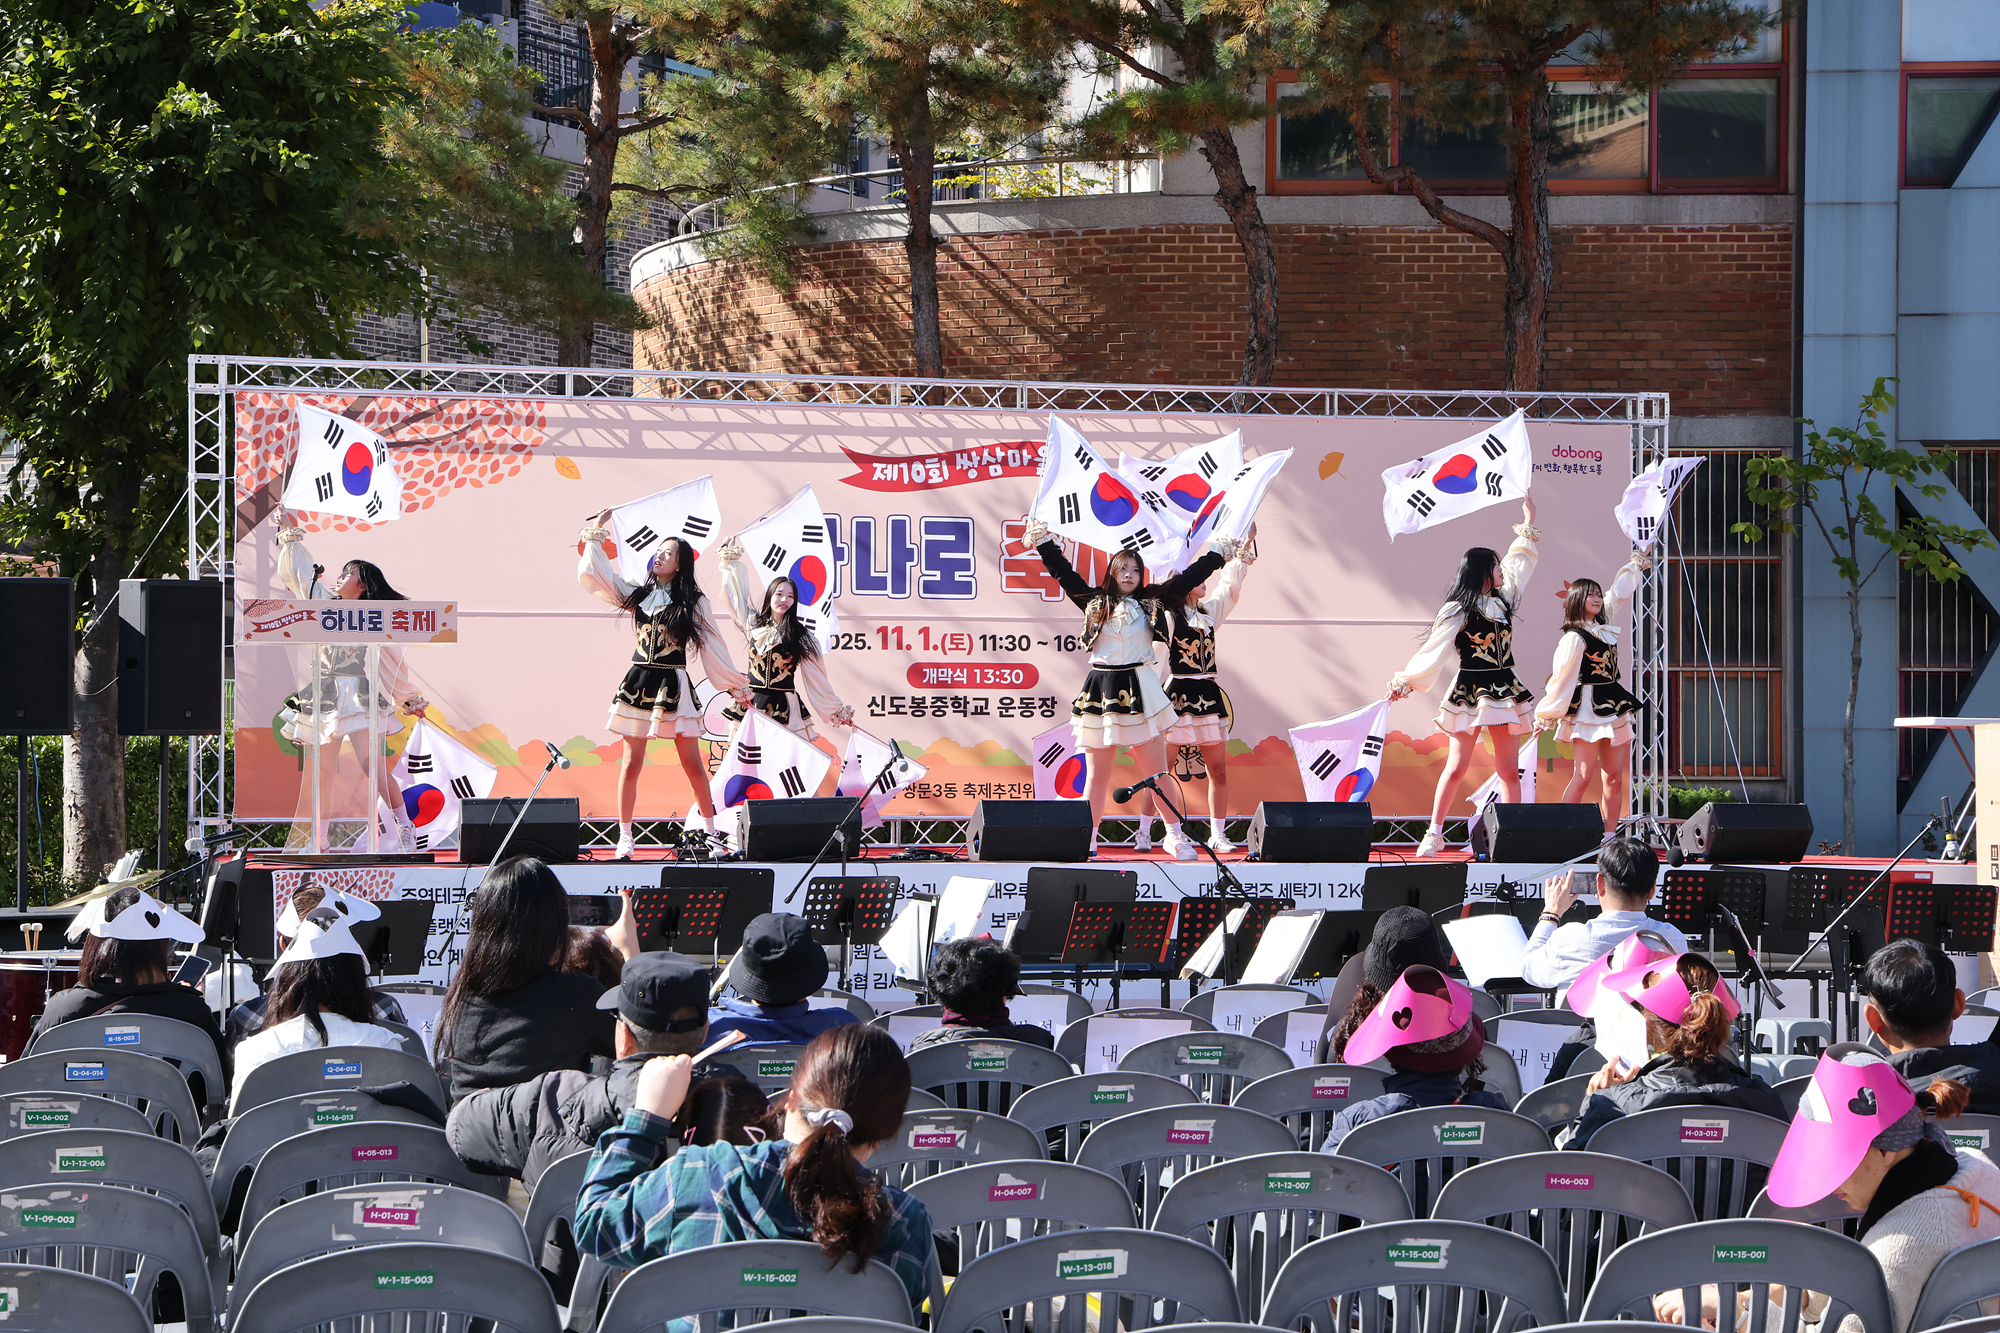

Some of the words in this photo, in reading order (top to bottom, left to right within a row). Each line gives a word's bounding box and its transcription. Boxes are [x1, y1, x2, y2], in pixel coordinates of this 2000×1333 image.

[1552, 445, 1602, 461] dobong
[872, 459, 949, 485] 제10회
[1563, 463, 1587, 474] 행복한
[1589, 464, 1602, 475] 도봉
[824, 515, 977, 600] 나로
[319, 608, 384, 633] 하나로
[389, 608, 436, 633] 축제
[831, 633, 872, 651] 025.
[876, 625, 912, 651] 11.
[979, 634, 1031, 652] 11:30
[922, 668, 968, 686] 개막식
[973, 668, 1024, 685] 13:30
[867, 695, 991, 718] 신도봉중학교
[996, 696, 1058, 719] 운동장
[902, 782, 958, 799] 쌍문3동
[1278, 883, 1323, 898] 세탁기
[1329, 883, 1366, 898] 12K
[1227, 1015, 1241, 1032] 내
[1102, 1044, 1118, 1063] 내
[1172, 1132, 1205, 1140] H-03-007
[1950, 1139, 1980, 1147] -05-005
[357, 1149, 393, 1157] H-05-013
[1268, 1181, 1310, 1189] X-1-12-007
[1550, 1177, 1589, 1186] H-06-003
[994, 1187, 1032, 1197] H-04-007
[24, 1214, 75, 1223] V-1-09-003
[370, 1211, 409, 1220] H-01-013
[1389, 1250, 1439, 1259] W-1-15-008
[1717, 1250, 1766, 1259] W-1-15-001
[1063, 1262, 1113, 1274] W-1-13-018
[377, 1276, 433, 1285] W-1-15-003
[743, 1273, 797, 1283] W-1-15-002
